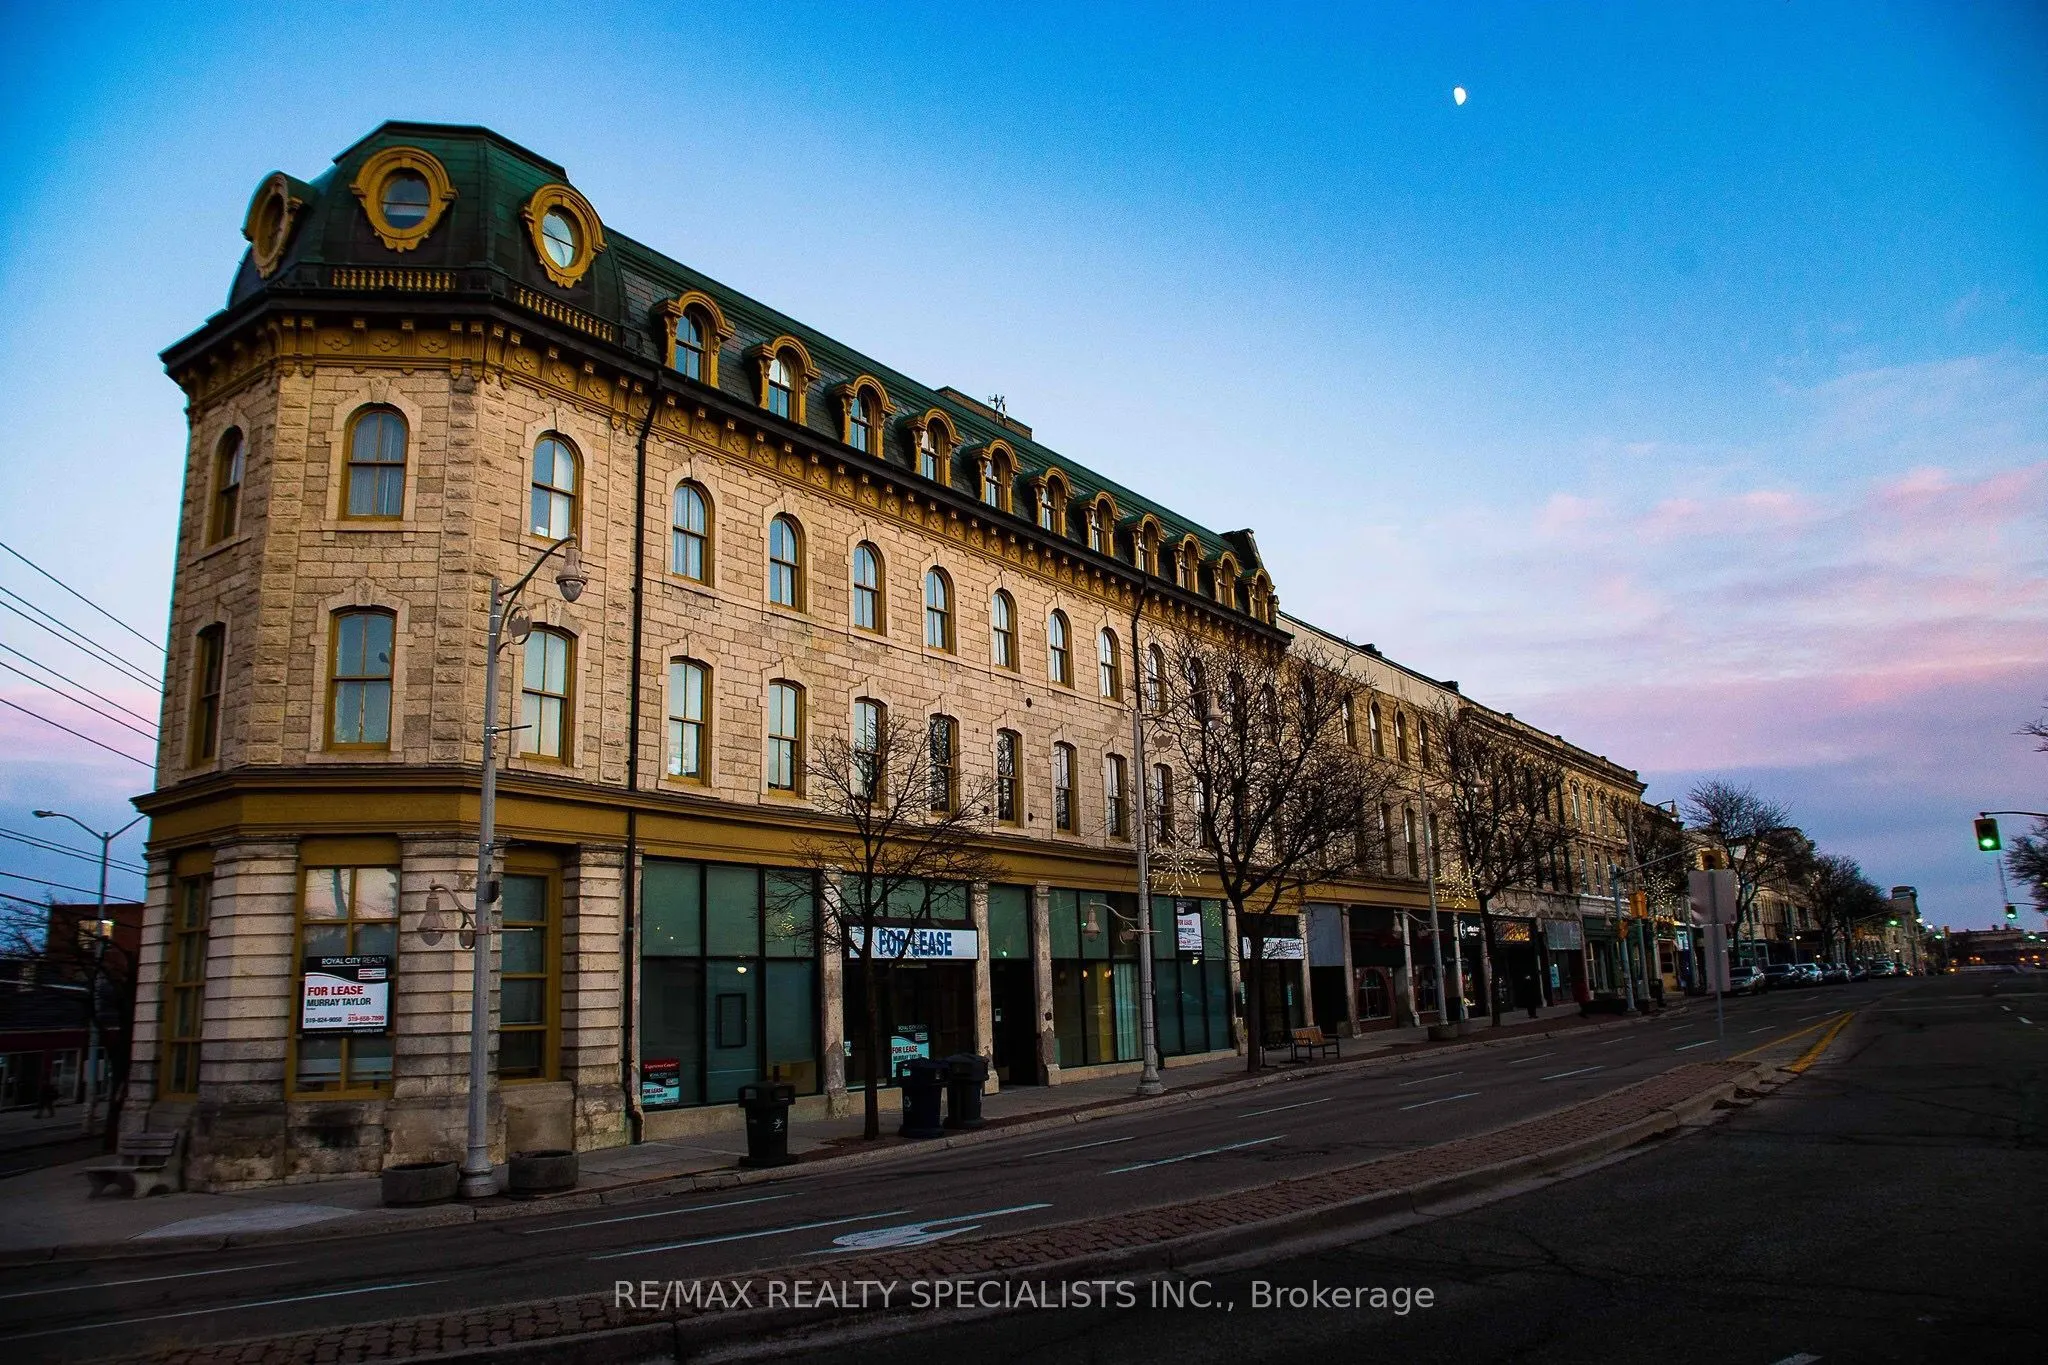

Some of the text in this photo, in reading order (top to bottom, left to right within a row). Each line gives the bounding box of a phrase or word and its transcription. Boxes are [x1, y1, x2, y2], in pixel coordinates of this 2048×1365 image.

[879, 930, 952, 956] FOR LEASE
[308, 986, 364, 996] FOR LEASE
[306, 997, 371, 1007] MURRAY TAYLOR
